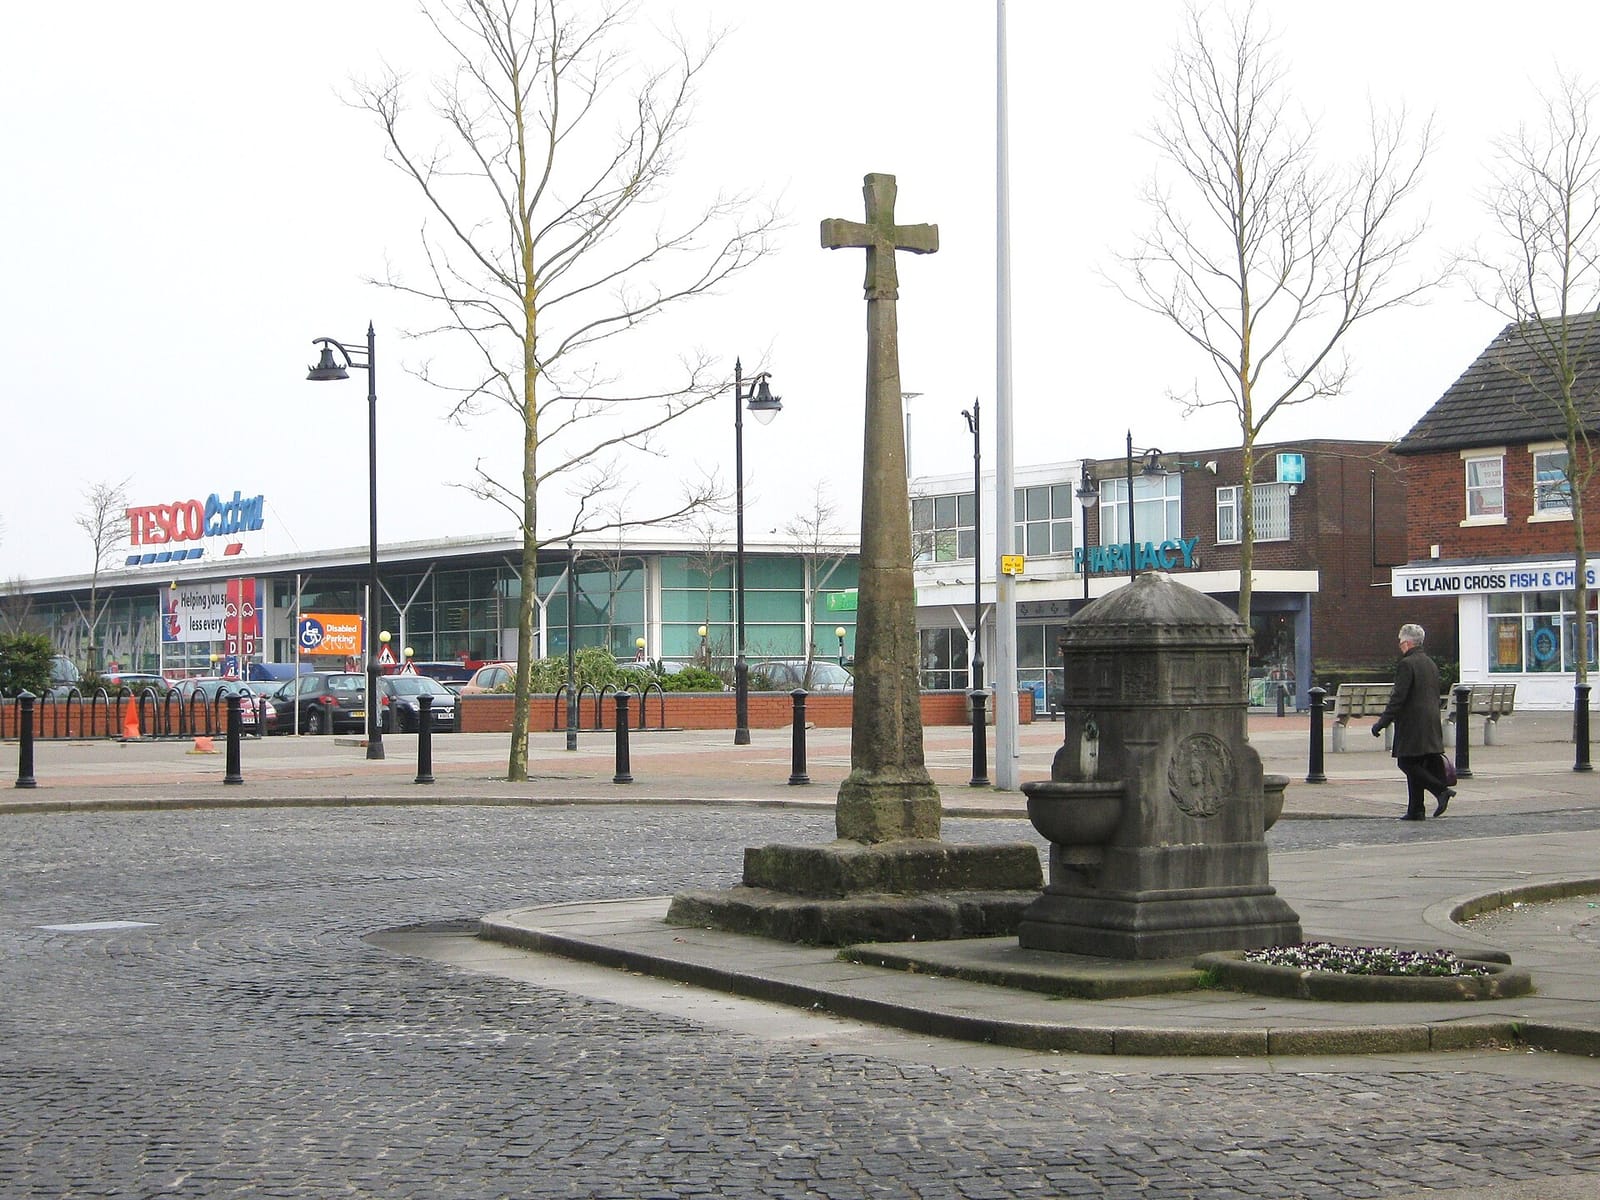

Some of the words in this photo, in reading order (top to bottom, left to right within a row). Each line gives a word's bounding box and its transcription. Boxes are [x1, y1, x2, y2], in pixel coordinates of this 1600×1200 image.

[126, 499, 206, 545] TESCO
[1074, 536, 1199, 573] PHARMACY
[1406, 576, 1460, 592] LEYLAND
[1464, 575, 1506, 590] CROSS
[1509, 573, 1538, 587] FISH
[1542, 572, 1551, 586] &
[1555, 570, 1596, 586] CHS
[181, 592, 206, 610] Helping
[207, 594, 220, 609] you
[189, 616, 203, 631] less
[203, 618, 223, 633] every
[326, 624, 357, 633] Disabled
[229, 641, 237, 654] D
[246, 641, 253, 654] D
[326, 634, 353, 644] Parking
